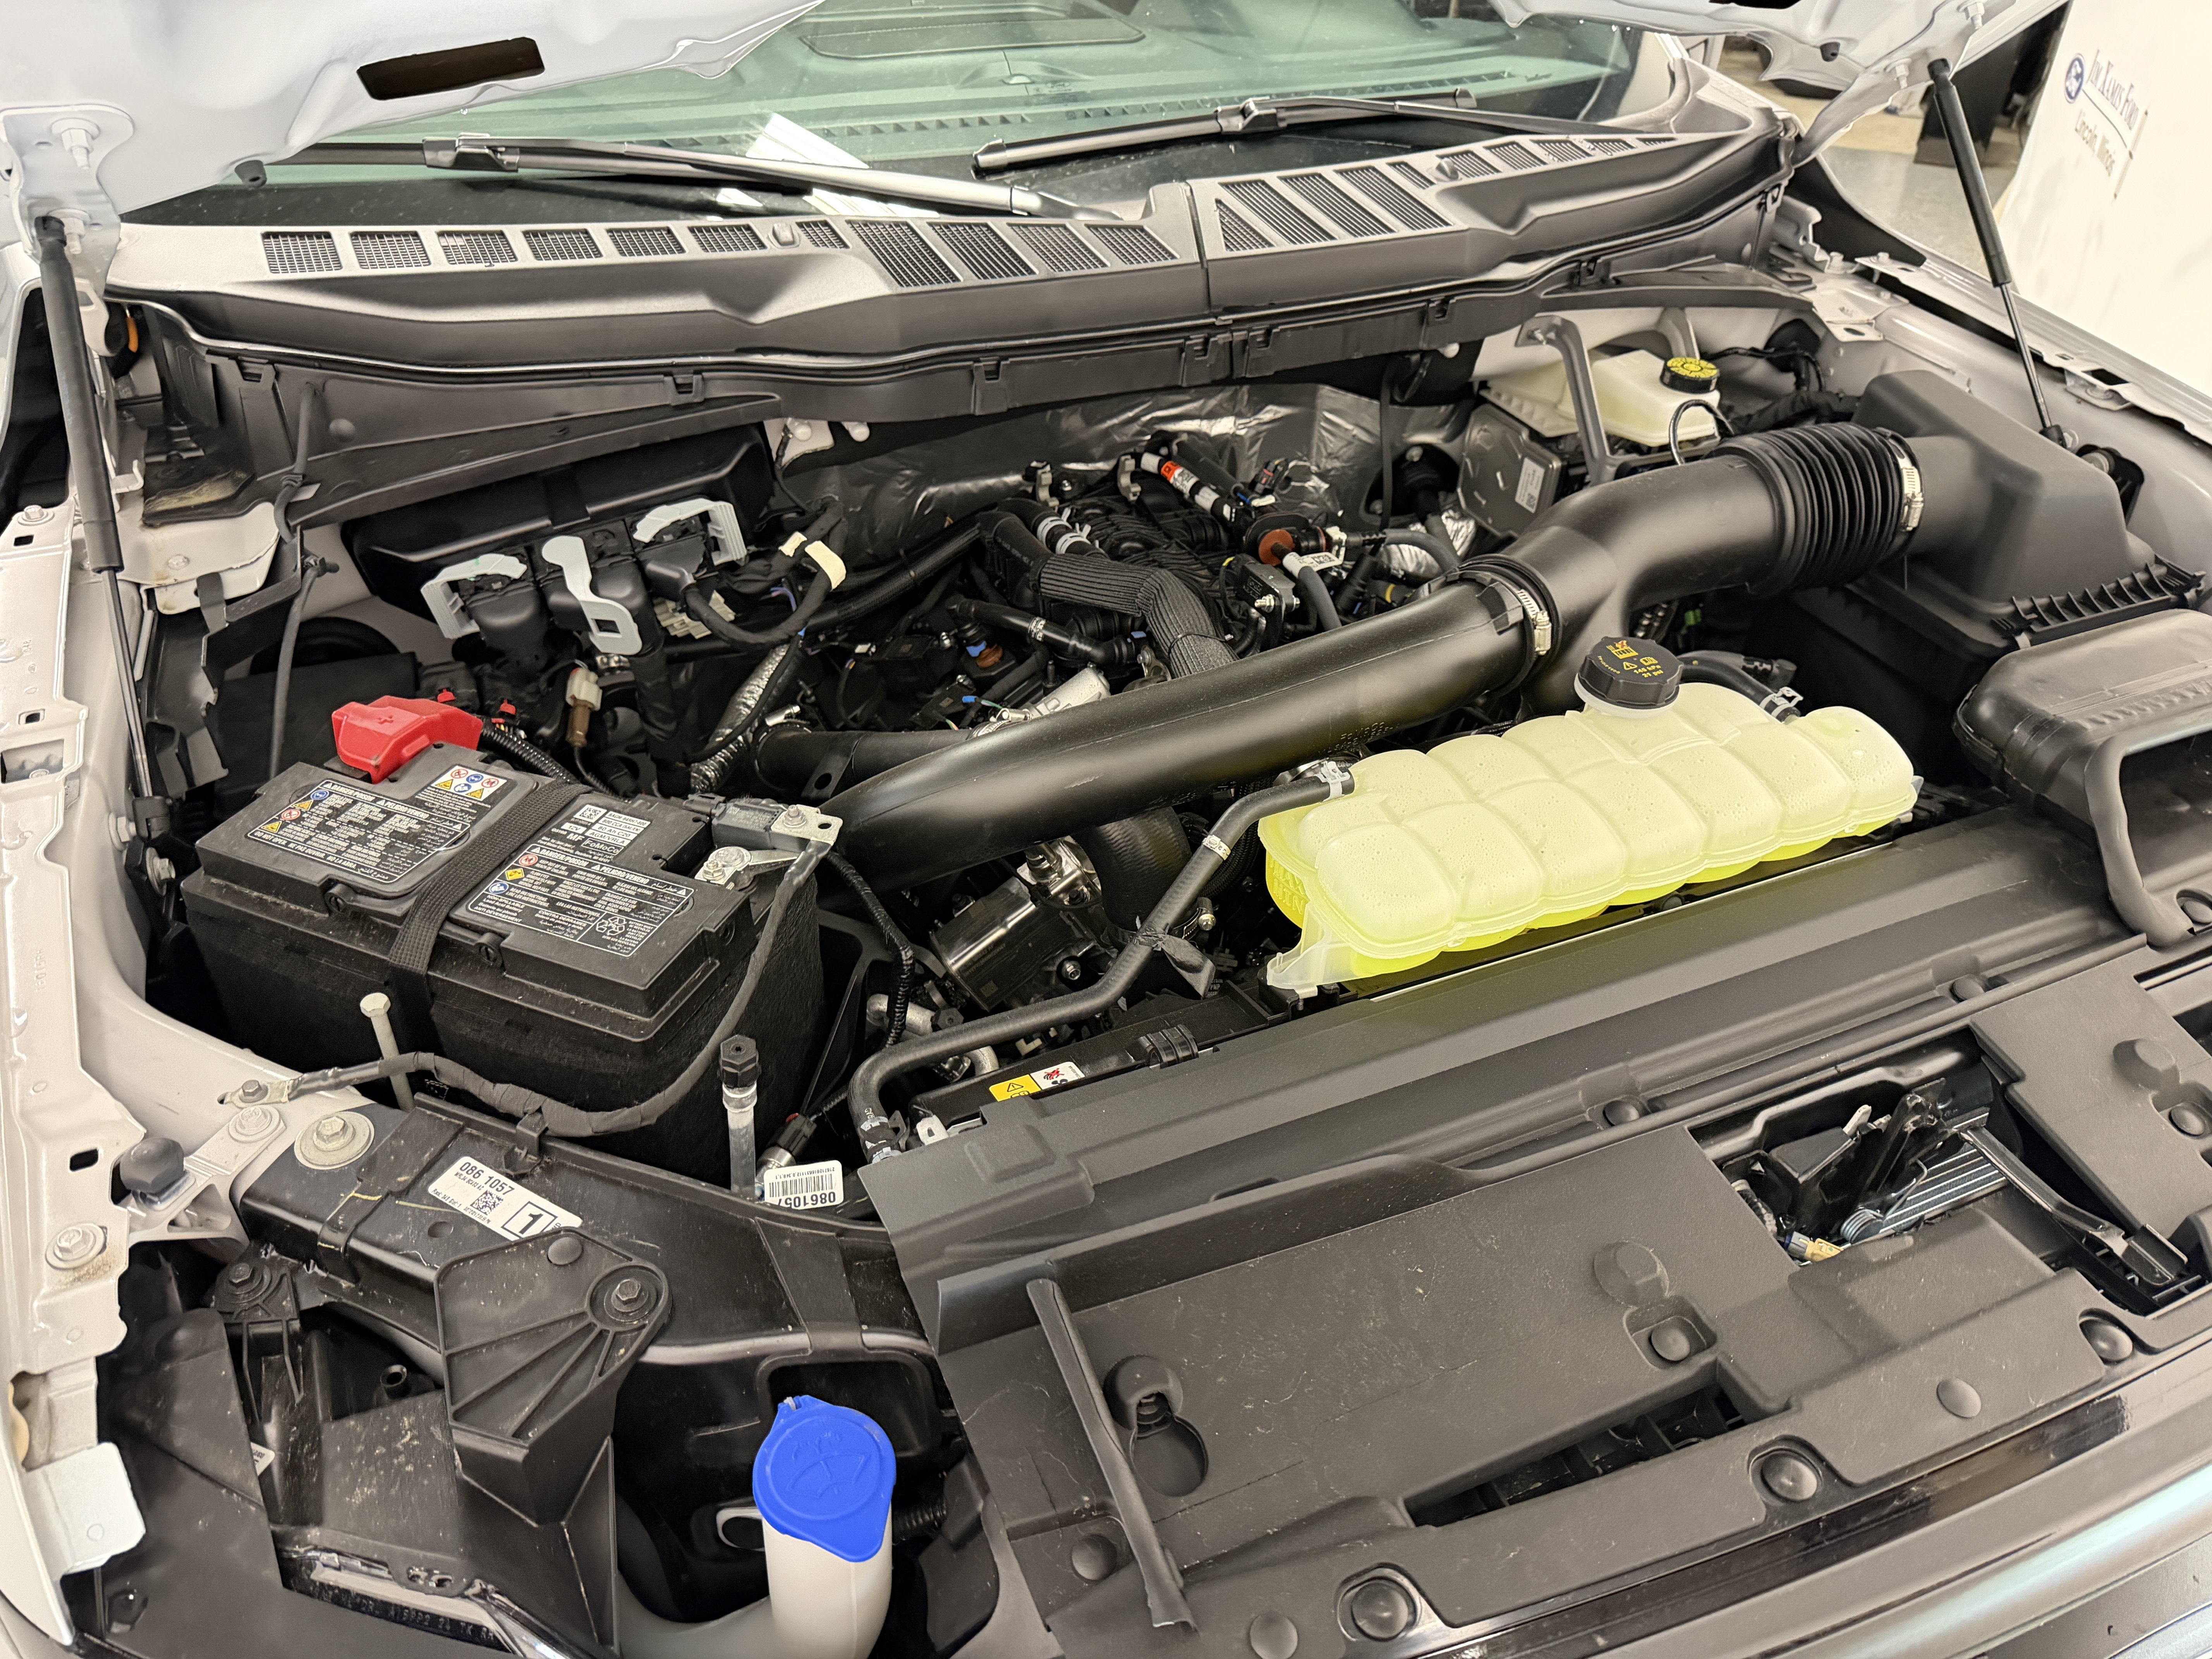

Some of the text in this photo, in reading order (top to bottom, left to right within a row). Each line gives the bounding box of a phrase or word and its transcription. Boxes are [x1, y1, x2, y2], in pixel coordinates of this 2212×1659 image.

[566, 833, 585, 841] MF
[589, 831, 625, 844] AGM/VRLA
[271, 837, 287, 845] OPEN.
[304, 848, 325, 858] OUVRIR.
[341, 860, 357, 869] ABRA.
[584, 840, 621, 854] FoMoCo
[539, 849, 588, 866] DANGER/POISON
[600, 866, 649, 884] PELIGRO/VENENO
[486, 895, 525, 908] NON-SPILLABLE
[1273, 878, 1304, 915] MIN
[505, 904, 523, 913] Battery
[538, 910, 587, 927] CONTRA DERRAMES
[459, 1162, 515, 1196] 086 1057
[518, 1212, 544, 1235] 1
